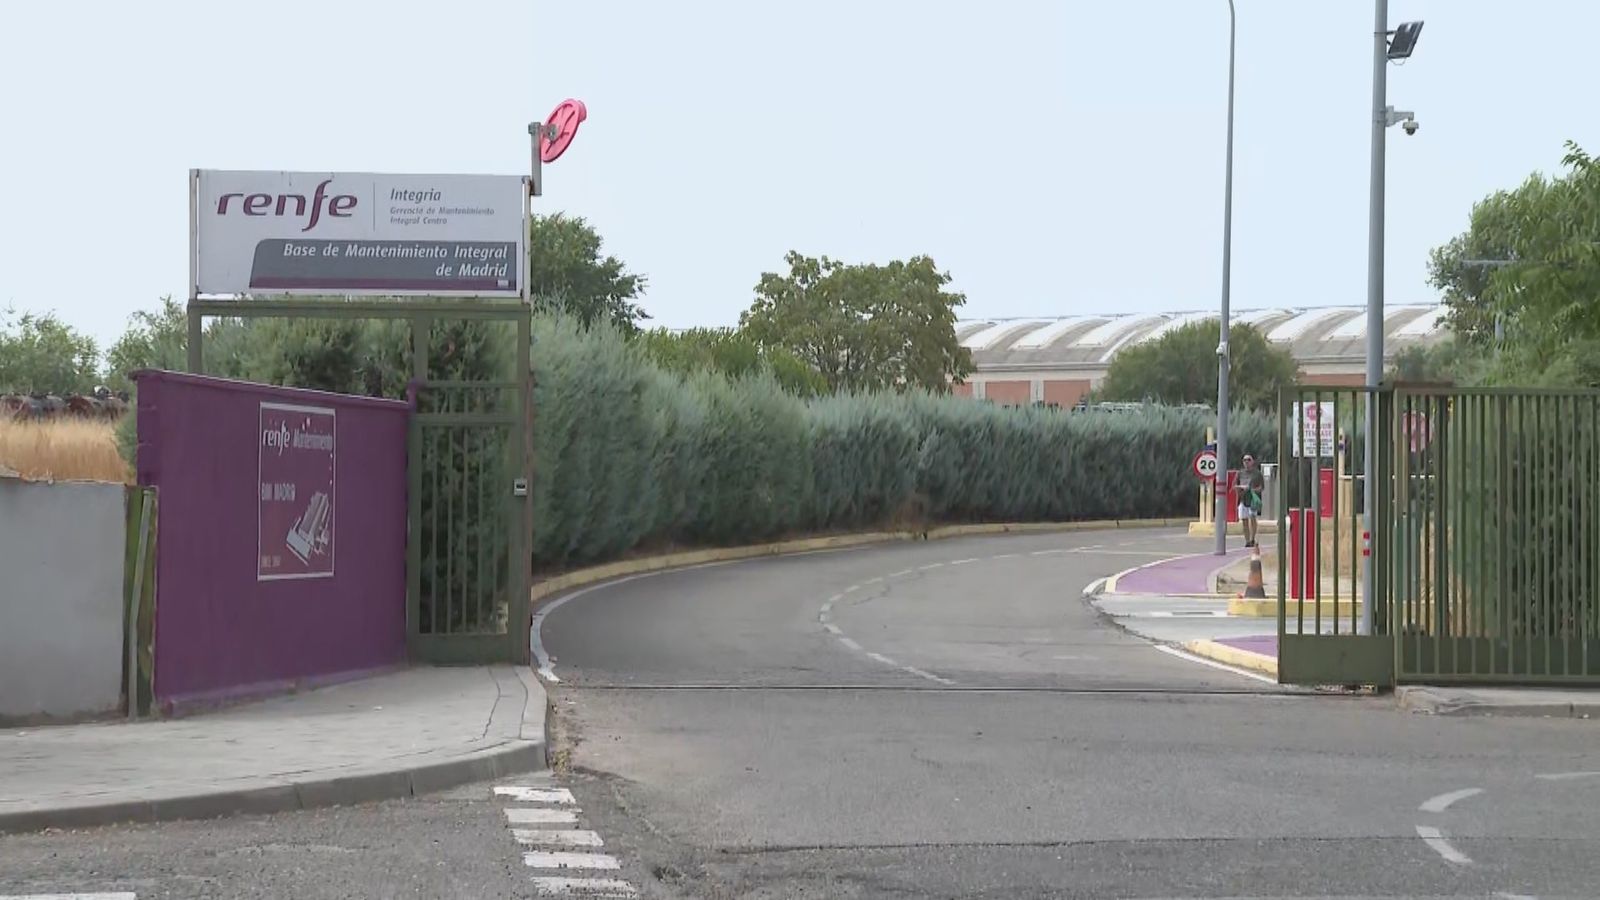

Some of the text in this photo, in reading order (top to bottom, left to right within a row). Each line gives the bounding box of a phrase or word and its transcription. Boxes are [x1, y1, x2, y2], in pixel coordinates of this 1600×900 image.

[390, 188, 442, 204] Integria
[217, 179, 358, 232] renfe
[426, 207, 436, 215] de
[439, 207, 495, 216] Mantenimiento
[390, 216, 448, 226] Integral Centro
[283, 243, 508, 261] Base de Mantenimiento Integral
[436, 262, 508, 277] de Madrid
[262, 420, 291, 456] renfe
[1200, 460, 1216, 470] 20
